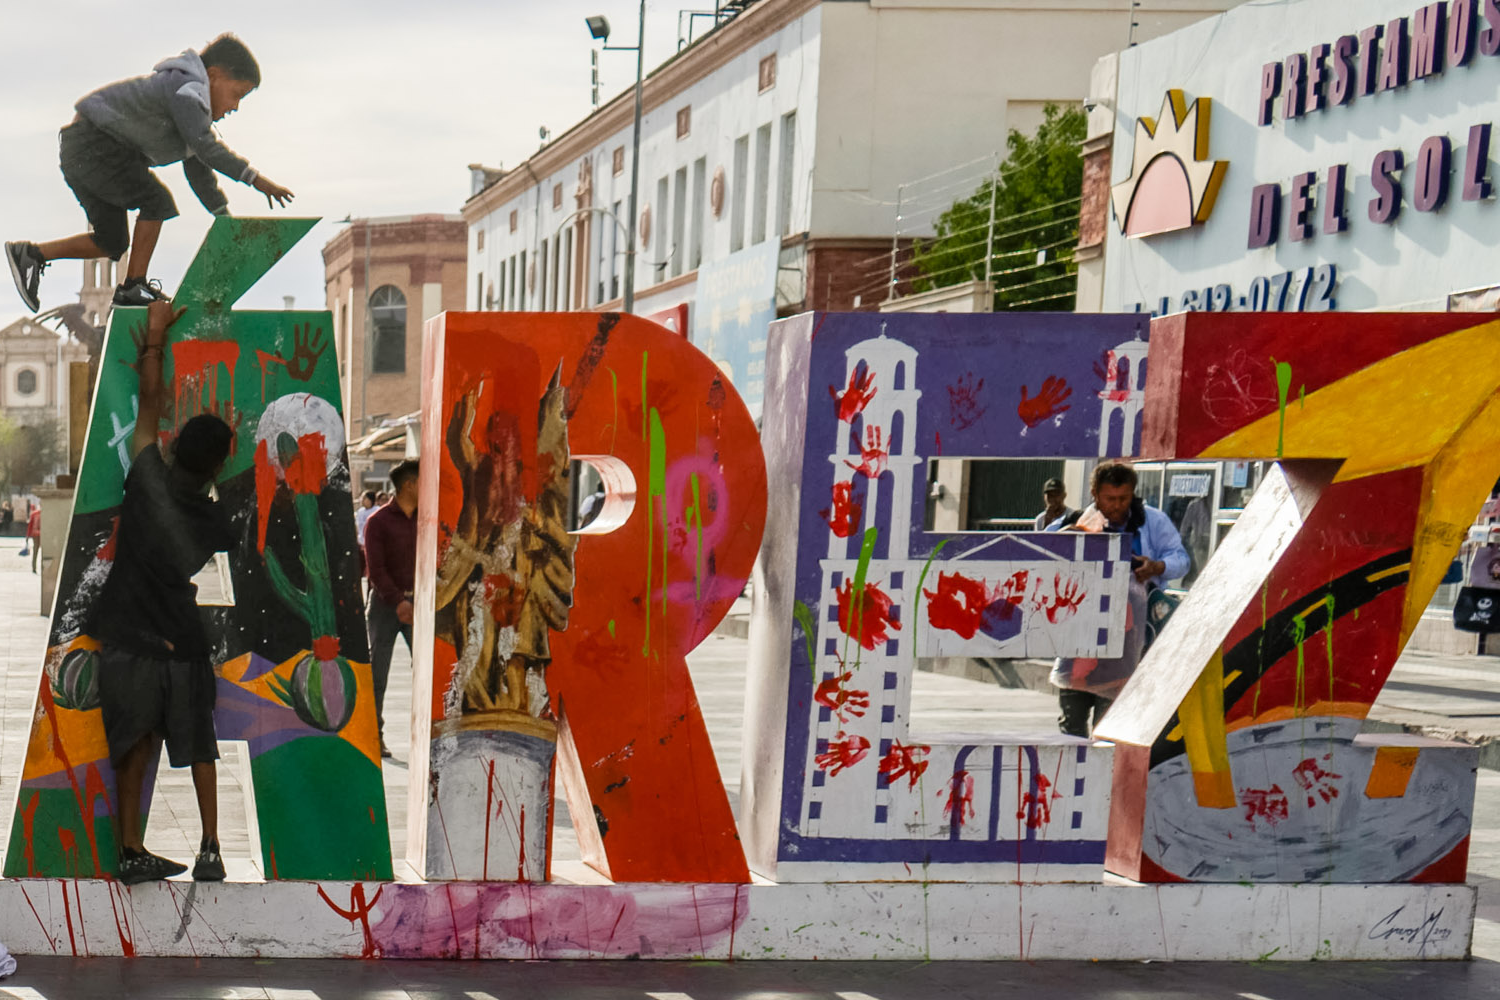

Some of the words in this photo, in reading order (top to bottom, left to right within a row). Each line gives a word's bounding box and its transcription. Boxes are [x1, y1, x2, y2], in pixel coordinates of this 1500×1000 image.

[1257, 0, 1500, 127] PRESTAMOS
[1247, 163, 1348, 249] DEL
[1368, 122, 1493, 224] SOL
